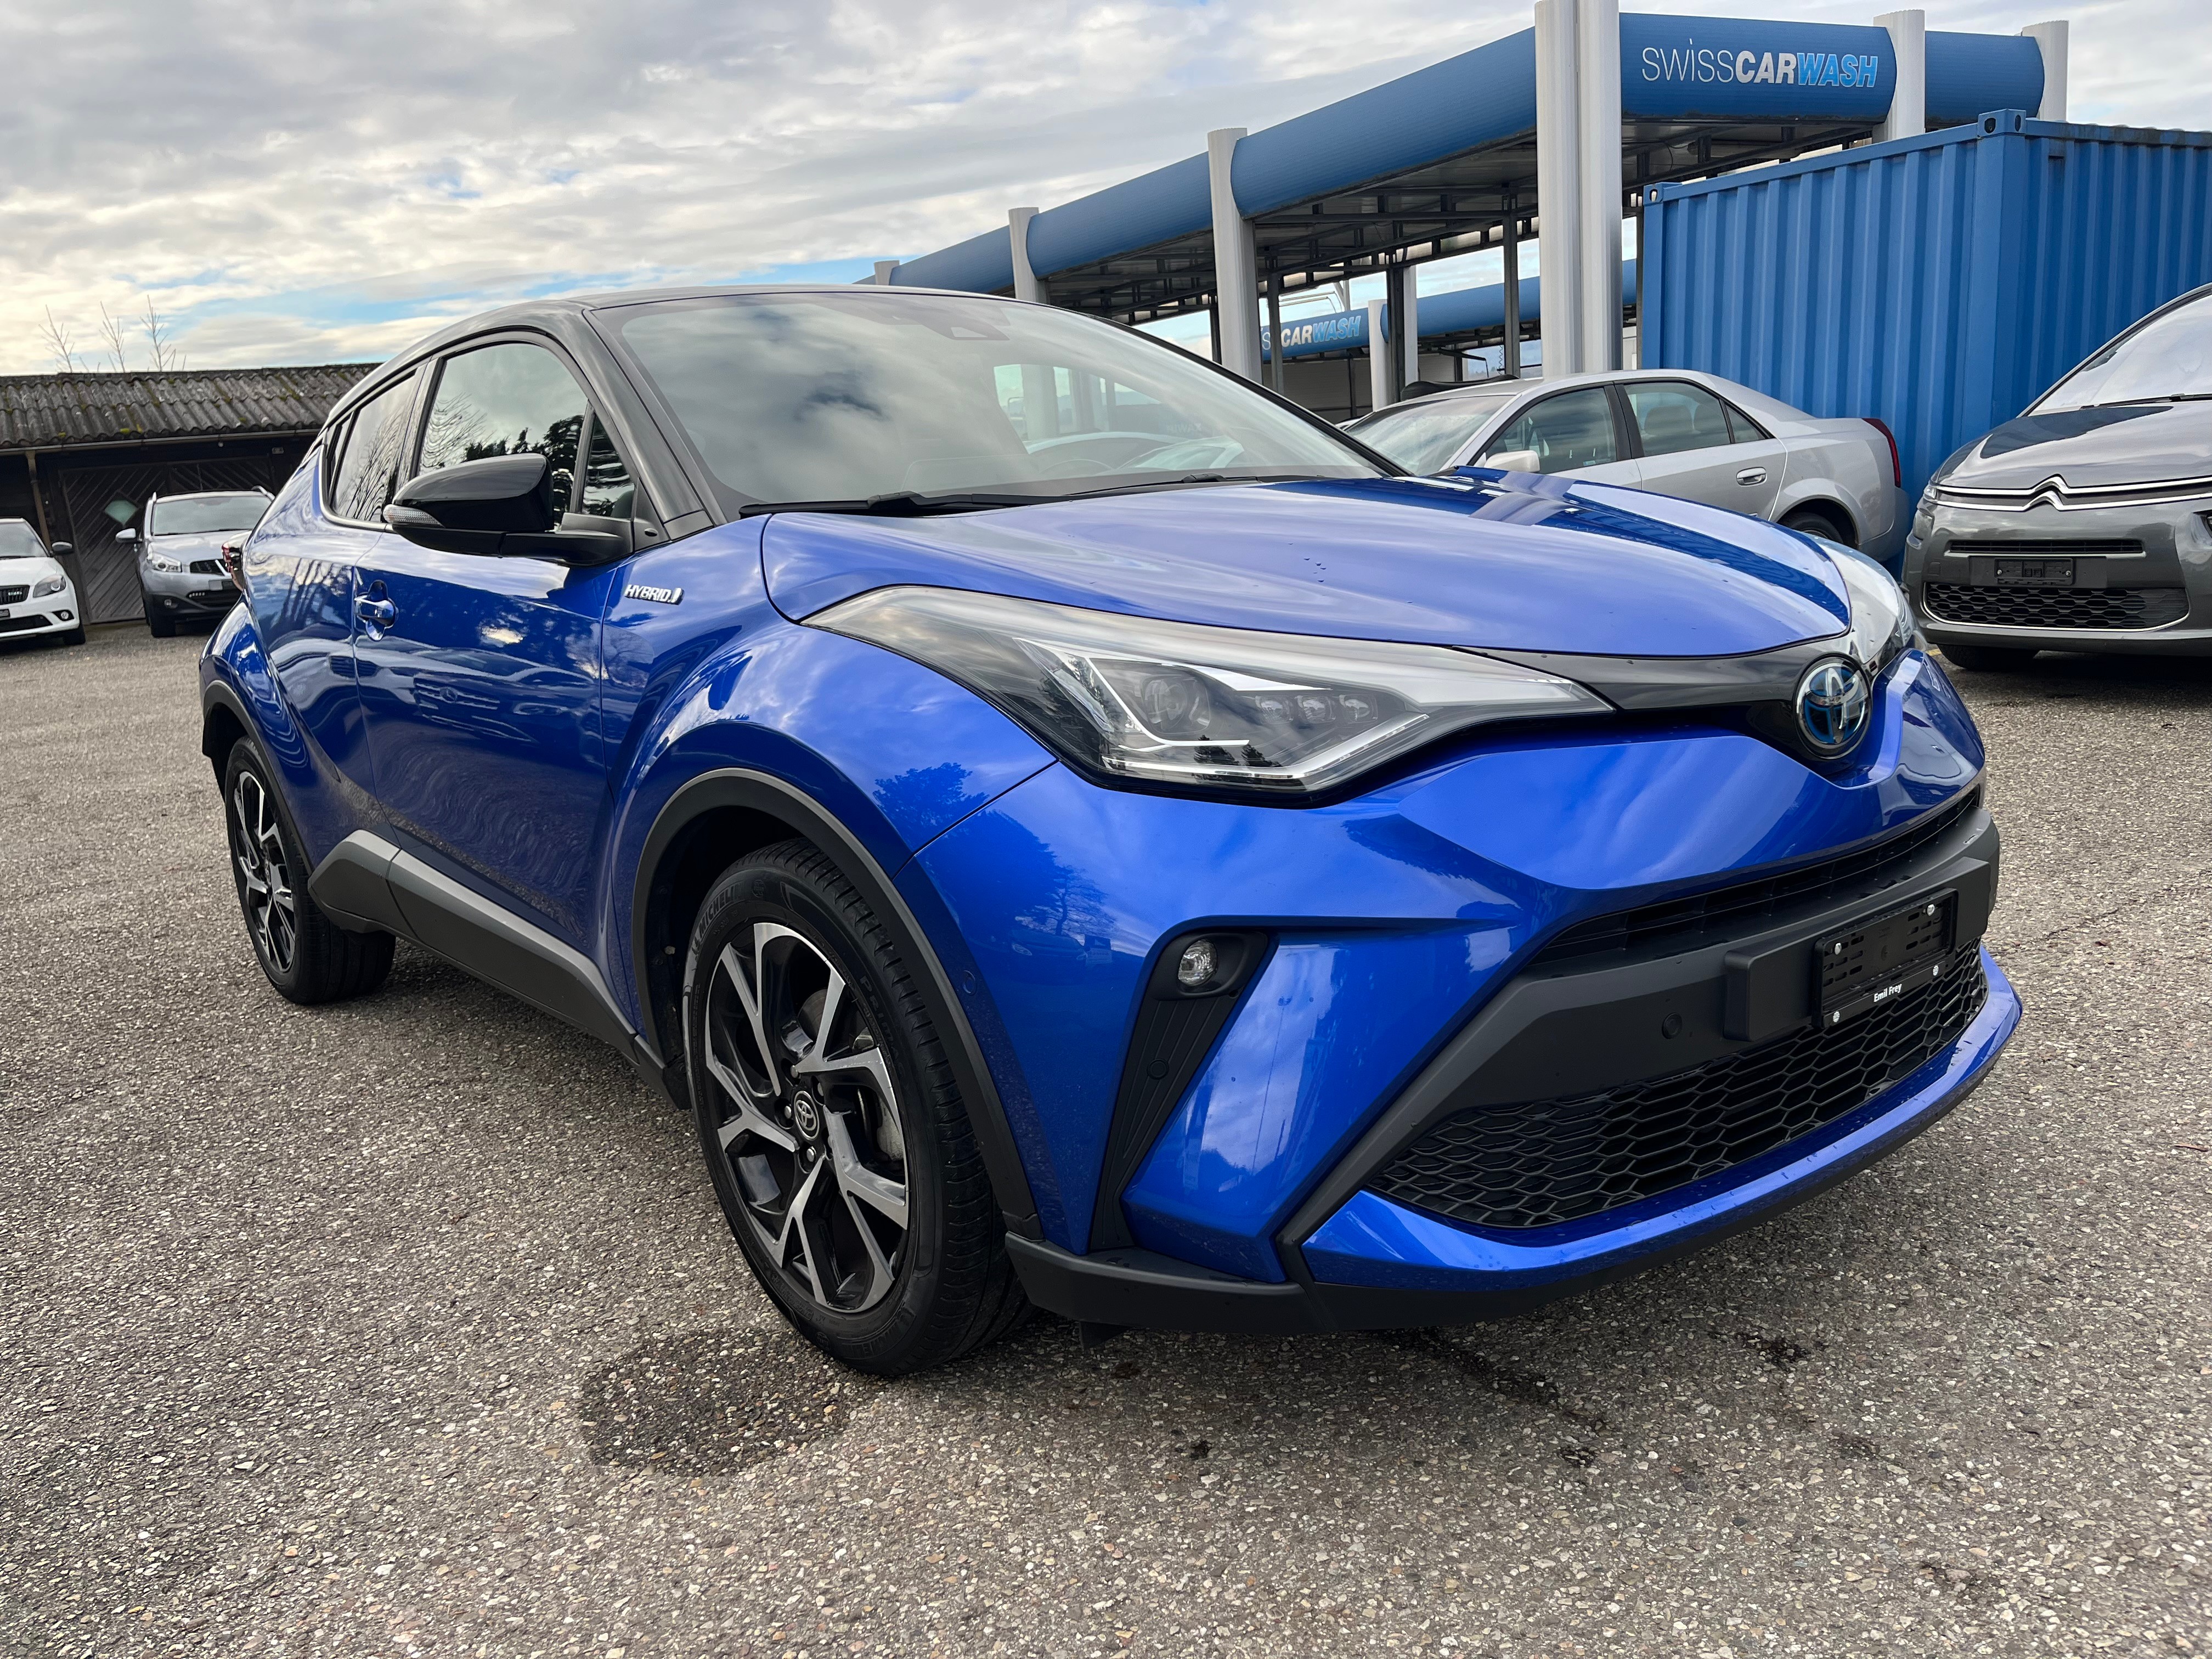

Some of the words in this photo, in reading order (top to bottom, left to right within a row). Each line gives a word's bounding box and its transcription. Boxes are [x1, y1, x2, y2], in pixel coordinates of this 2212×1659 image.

[624, 584, 672, 602] HYBRID
[1874, 988, 1888, 1002] Emil
[1888, 984, 1902, 995] Frey
